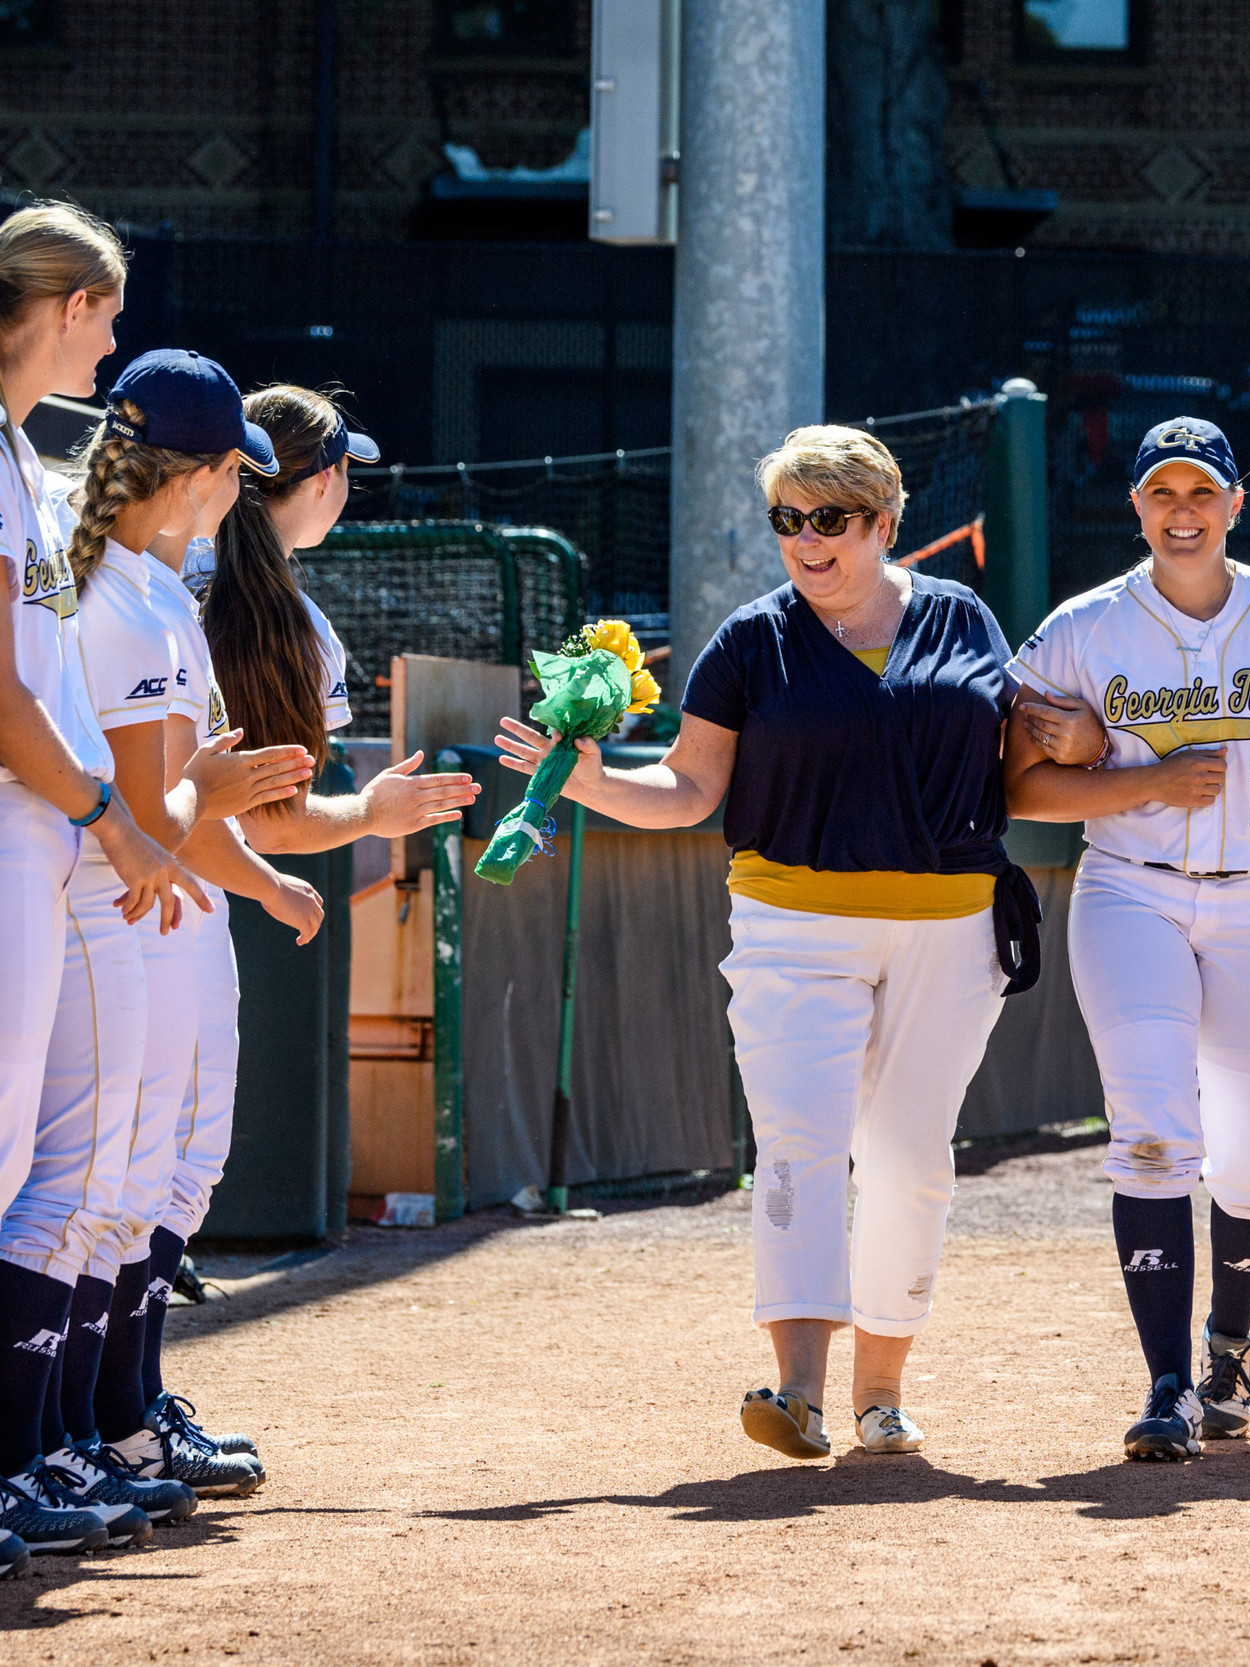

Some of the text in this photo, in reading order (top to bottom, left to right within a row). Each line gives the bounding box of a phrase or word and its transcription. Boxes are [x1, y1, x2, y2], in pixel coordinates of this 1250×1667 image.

[125, 677, 169, 699] ACC
[1103, 674, 1219, 725] Georgia
[1122, 1262, 1179, 1273] RUSSELL
